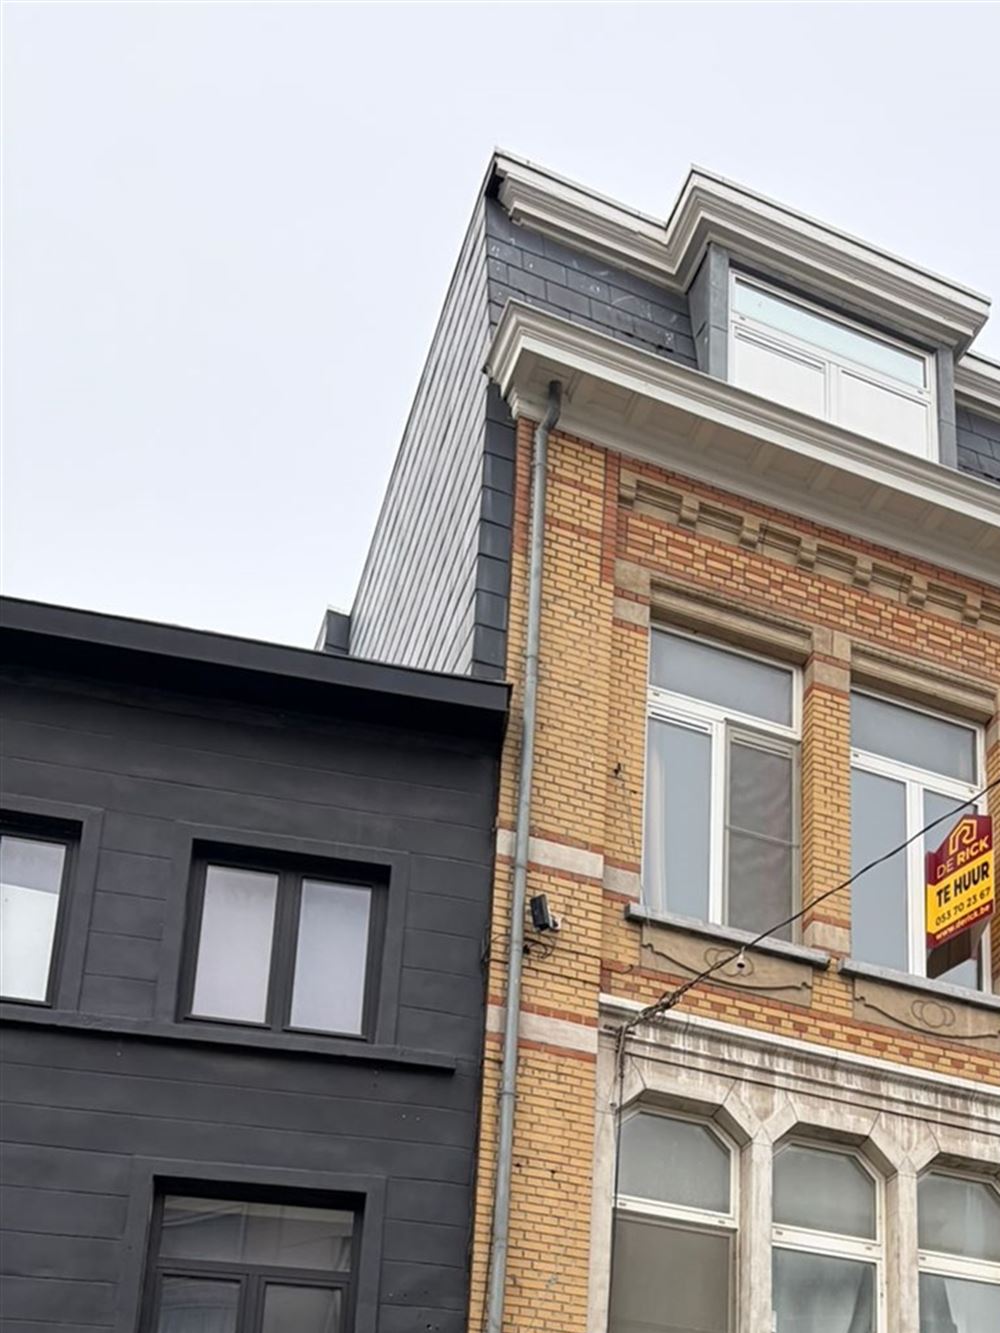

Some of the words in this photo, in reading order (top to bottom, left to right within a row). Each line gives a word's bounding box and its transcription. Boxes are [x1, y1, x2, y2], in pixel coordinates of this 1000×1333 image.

[937, 857, 954, 879] DE
[957, 836, 988, 864] RICK
[936, 888, 952, 907] TE
[954, 862, 990, 897] HUUR
